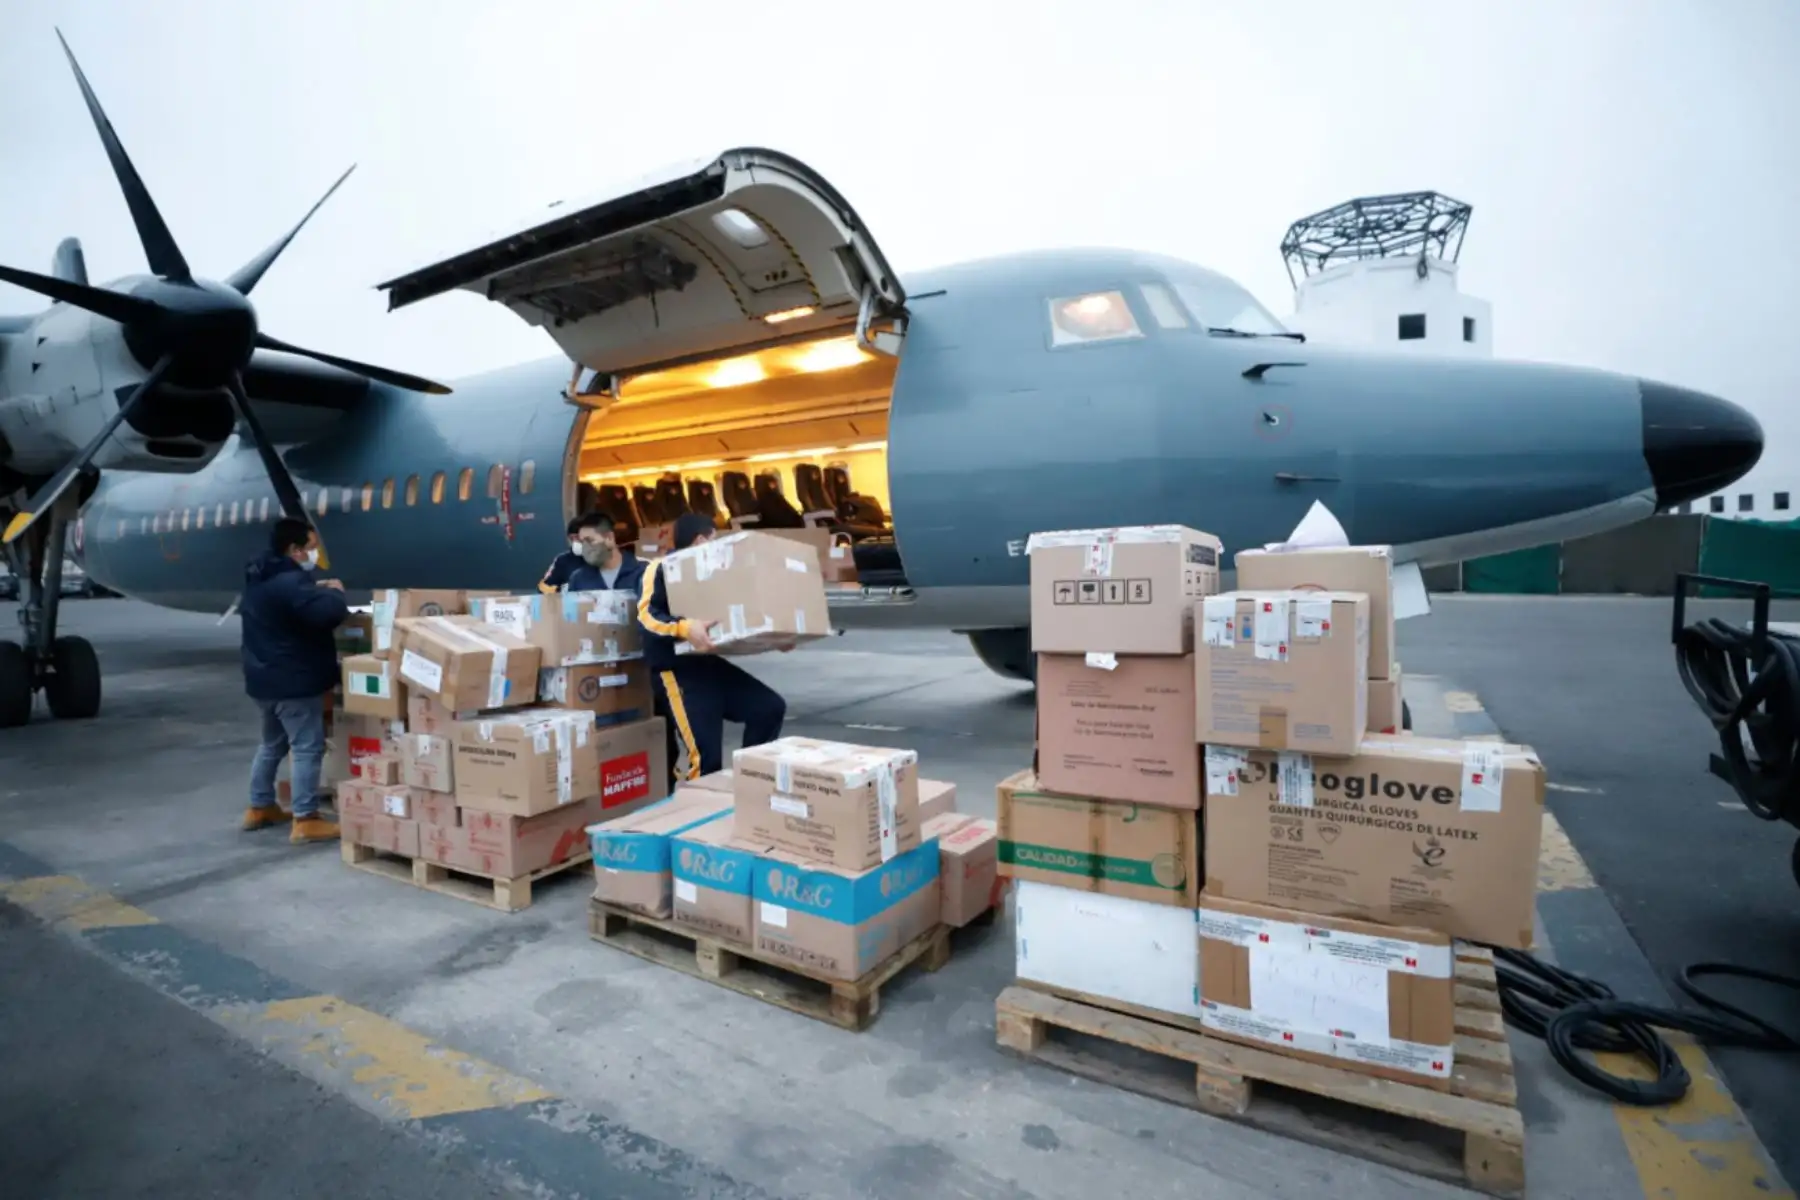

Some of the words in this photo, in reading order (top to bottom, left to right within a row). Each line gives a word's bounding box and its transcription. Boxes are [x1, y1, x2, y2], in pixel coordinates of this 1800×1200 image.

[603, 774, 646, 796] MAPFRE
[1269, 762, 1463, 805] oglove
[1268, 804, 1324, 819] GUANTES
[1416, 823, 1434, 836] DE
[1436, 824, 1479, 842] LATEX
[1313, 797, 1366, 813] URGICAL
[1368, 804, 1419, 820] GLOVES
[691, 853, 737, 883] R&G
[1015, 848, 1078, 868] CALIDAD
[783, 875, 834, 909] R&G
